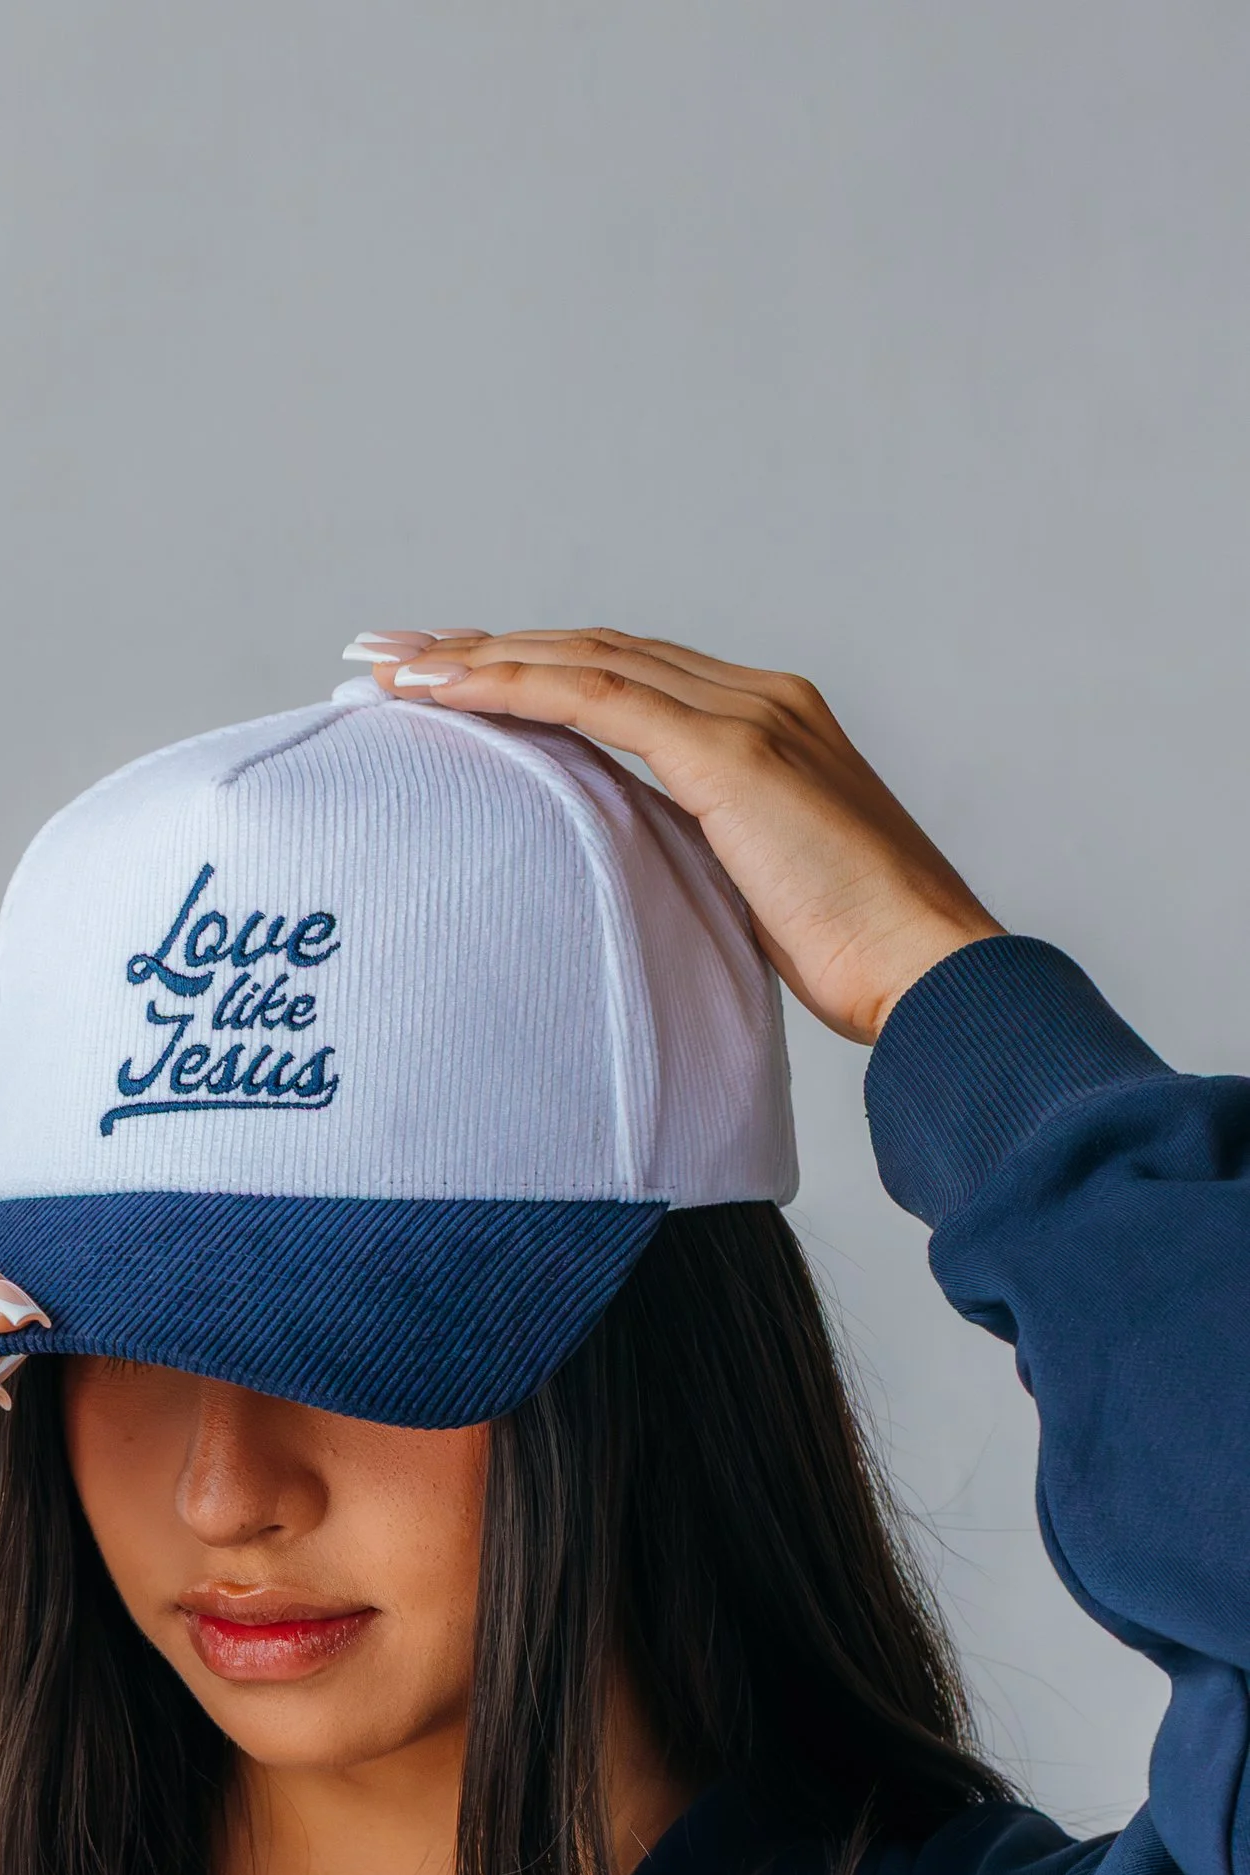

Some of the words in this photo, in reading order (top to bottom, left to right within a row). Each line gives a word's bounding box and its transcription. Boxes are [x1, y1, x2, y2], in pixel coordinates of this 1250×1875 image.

[126, 863, 341, 997] Love
[117, 999, 339, 1097] Jesus
[212, 972, 317, 1031] like
